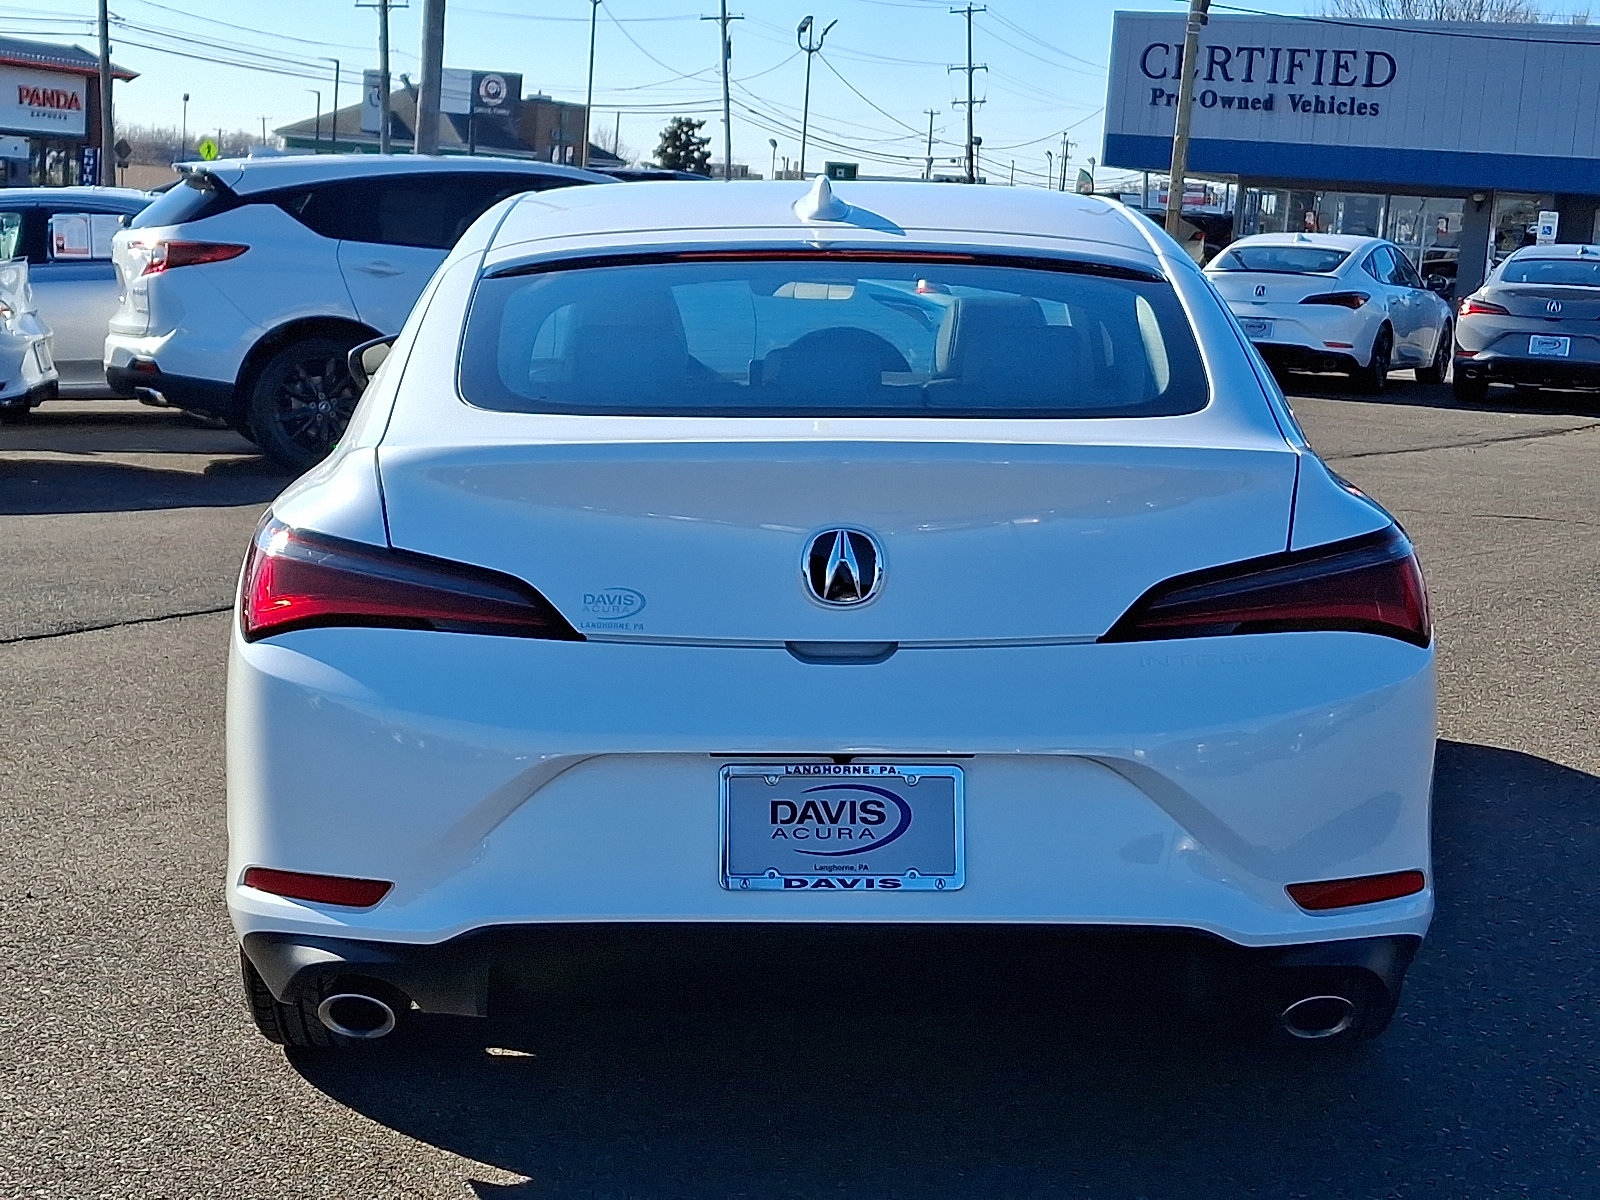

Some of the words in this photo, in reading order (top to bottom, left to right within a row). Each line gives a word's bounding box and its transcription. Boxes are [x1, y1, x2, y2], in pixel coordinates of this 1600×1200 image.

[18, 85, 81, 110] PANDA
[1150, 88, 1274, 112] Pr-Owned
[1288, 93, 1380, 116] Vehicles
[583, 594, 634, 605] DAVIS
[582, 605, 630, 613] ACURA
[770, 800, 886, 825] DAVIS
[771, 827, 876, 840] ACURA
[858, 864, 869, 872] PA
[783, 878, 902, 889] DAVIS
